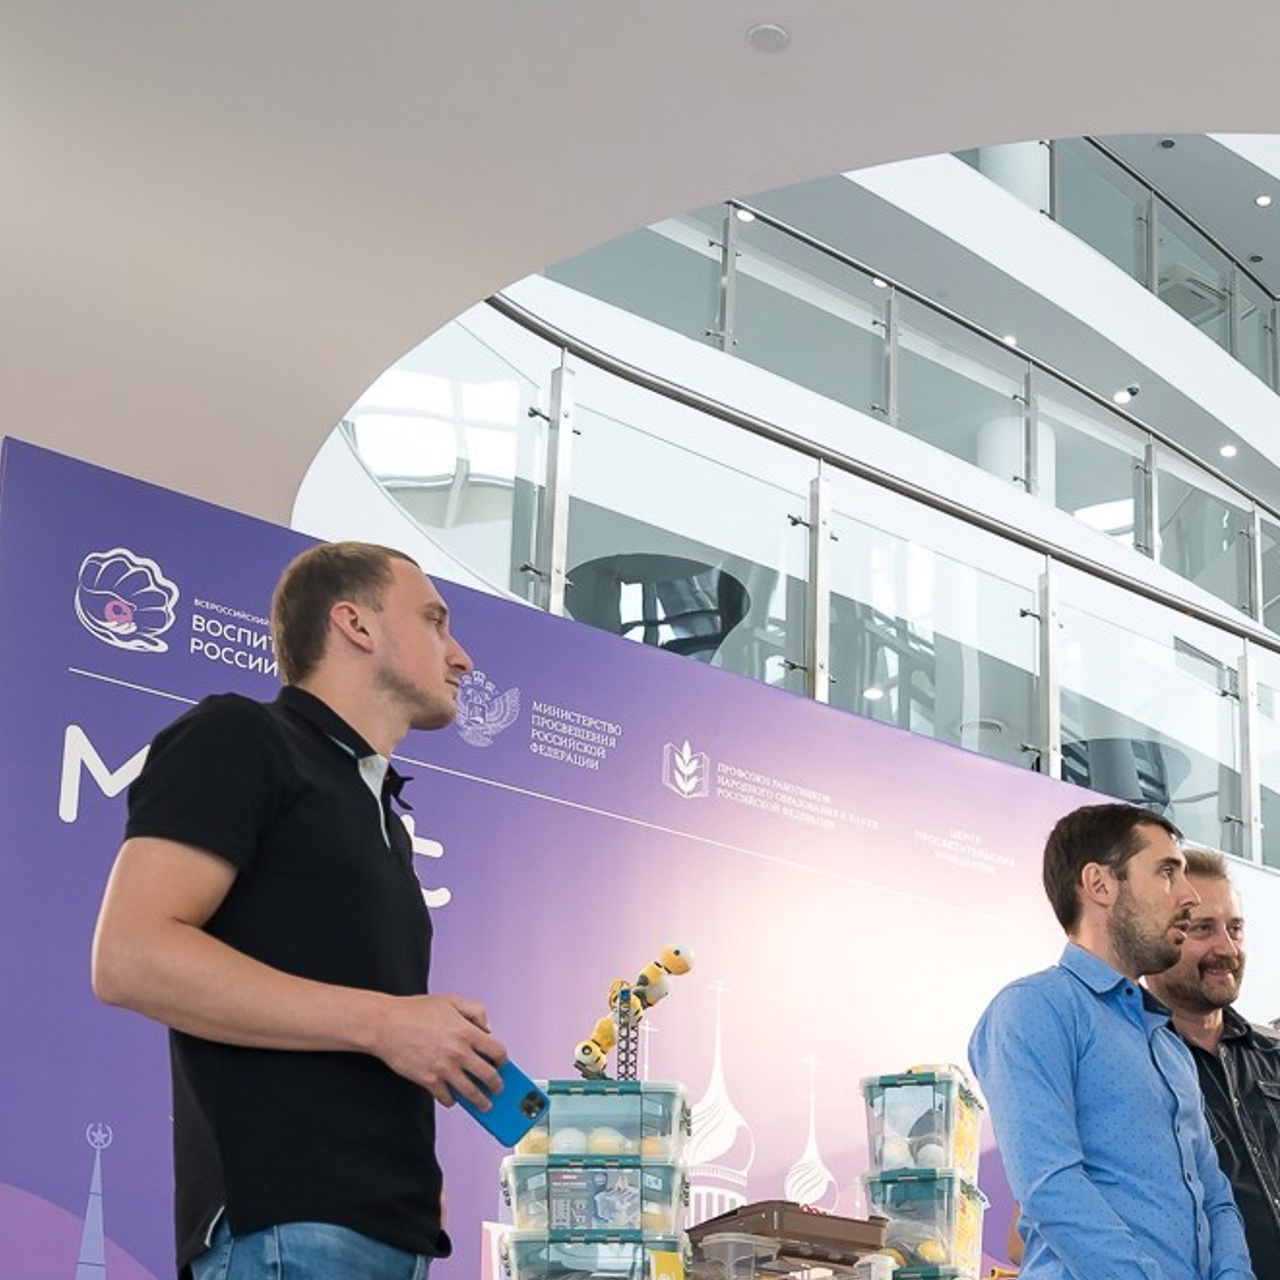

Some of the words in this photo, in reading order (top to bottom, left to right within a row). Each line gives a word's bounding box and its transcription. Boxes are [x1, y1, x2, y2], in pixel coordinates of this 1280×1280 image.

[192, 614, 275, 653] ВОСПИ
[190, 637, 279, 677] РОССИИ
[531, 700, 622, 736] МИНИСТЕРСТВО
[531, 714, 617, 748] ПРОСВЕЩЕНИЯ
[531, 729, 606, 759] РОССИЙСКОЙ
